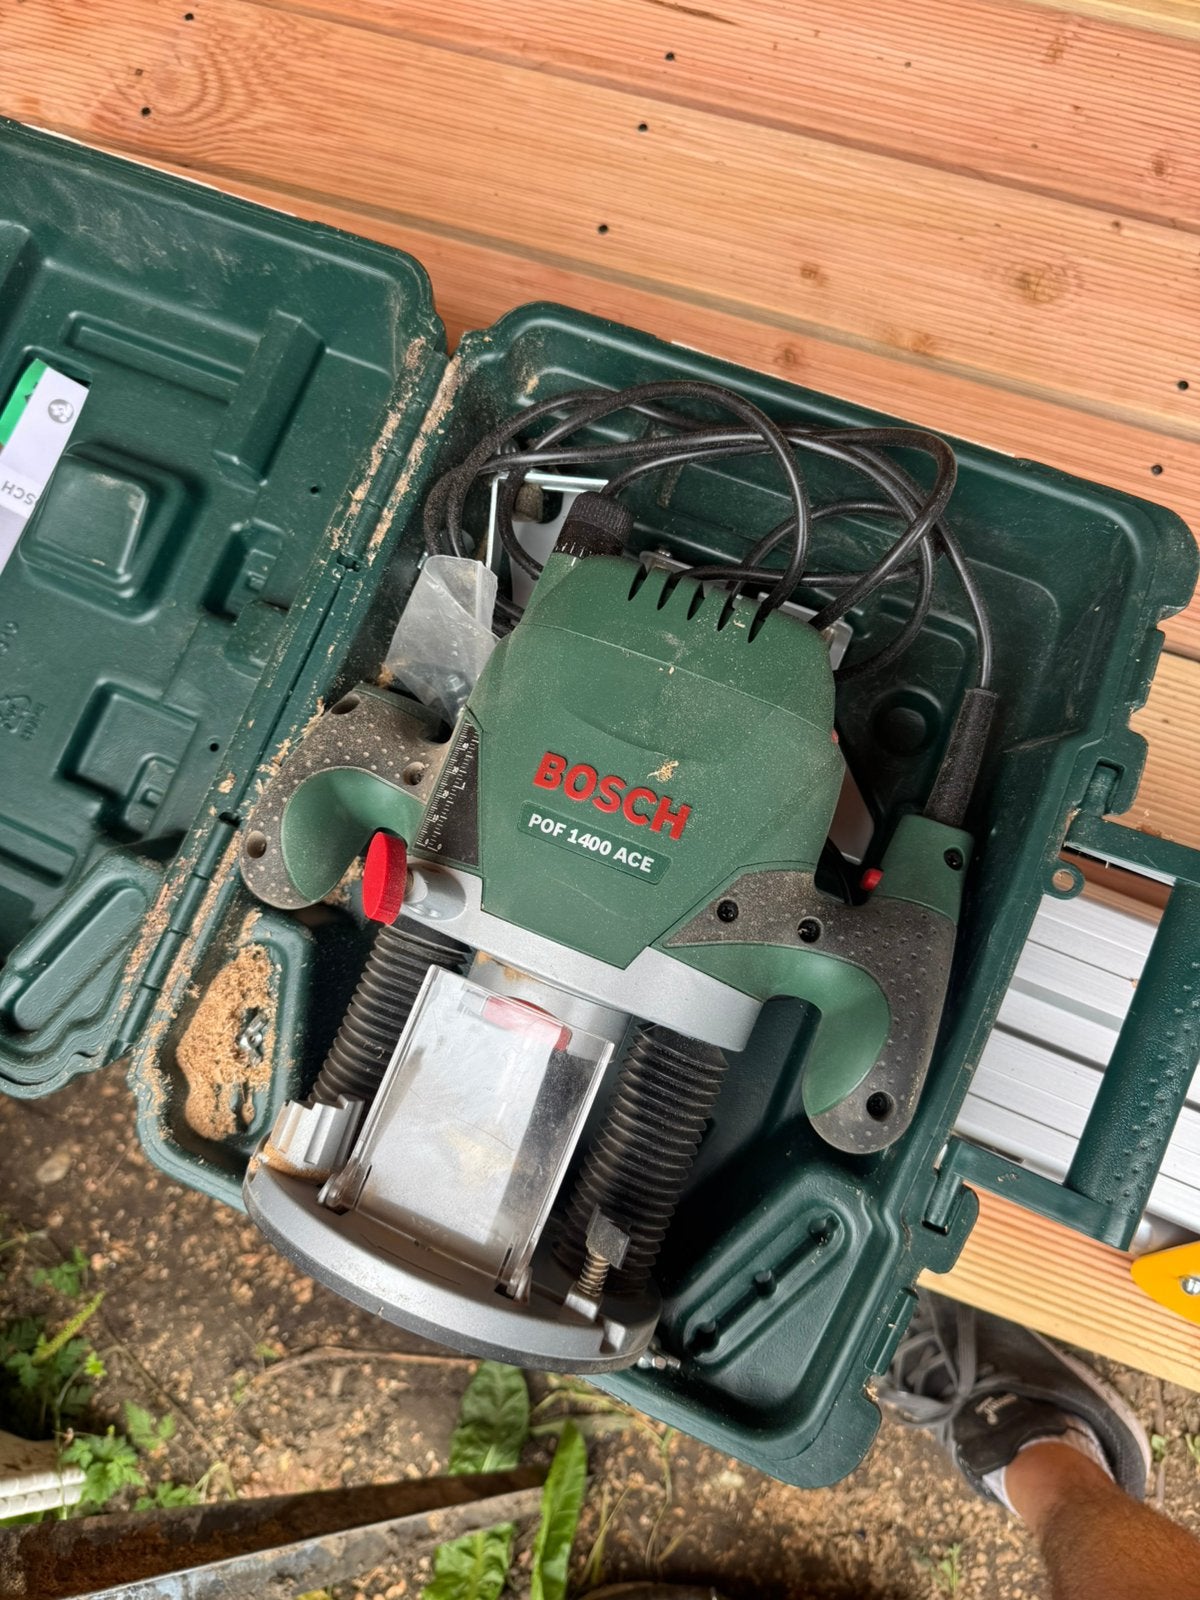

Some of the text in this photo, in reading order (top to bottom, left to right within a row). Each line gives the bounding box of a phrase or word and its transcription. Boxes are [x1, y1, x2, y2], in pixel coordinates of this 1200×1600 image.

[533, 751, 692, 841] BOSCH
[528, 813, 655, 873] POF 1400 ACE
